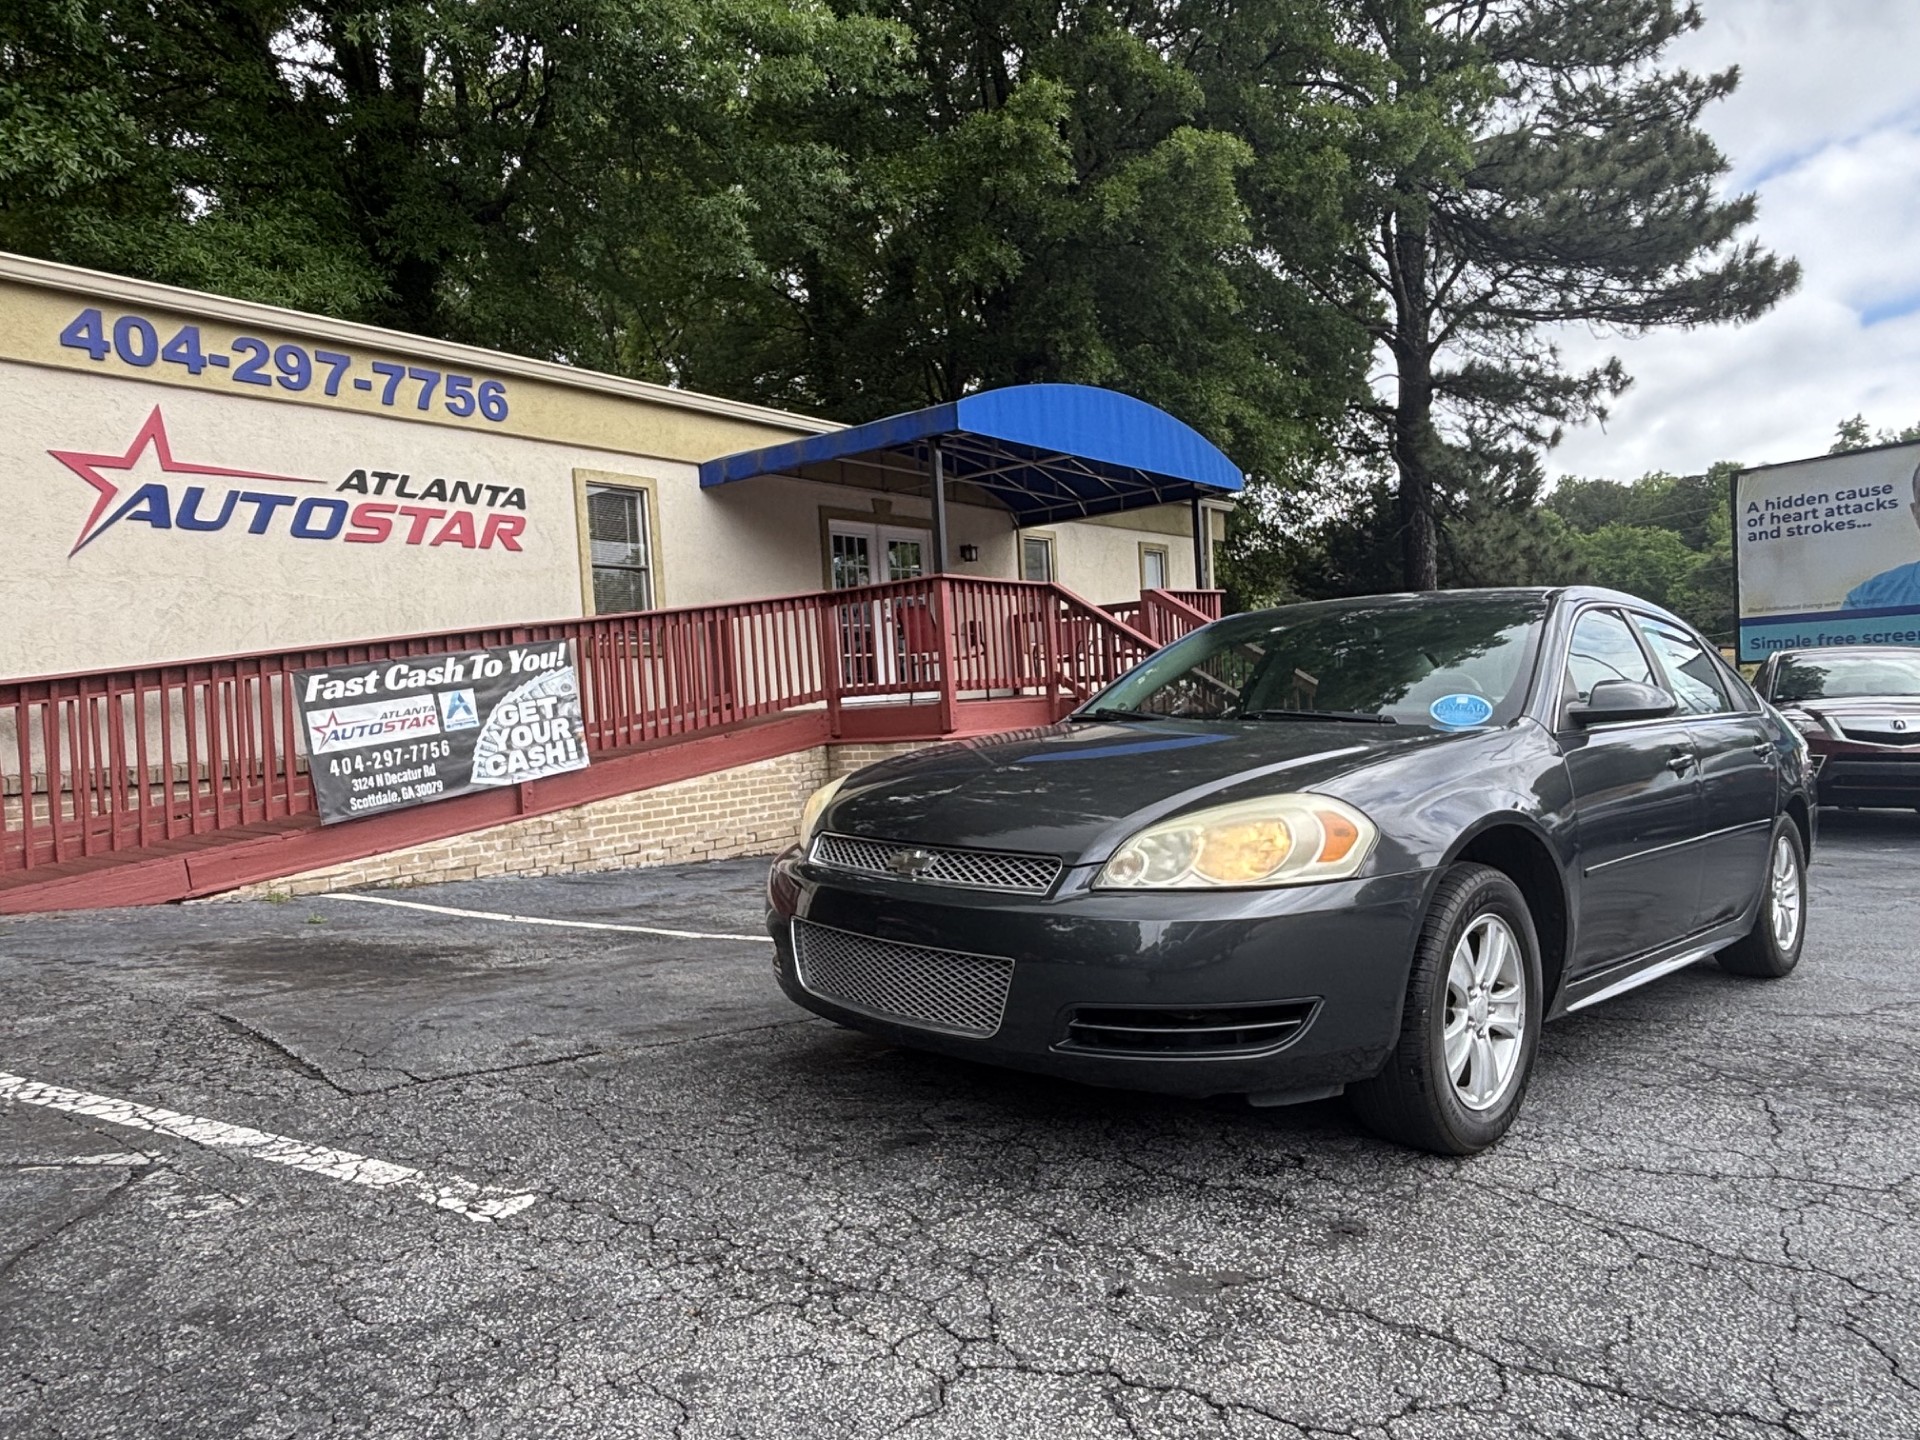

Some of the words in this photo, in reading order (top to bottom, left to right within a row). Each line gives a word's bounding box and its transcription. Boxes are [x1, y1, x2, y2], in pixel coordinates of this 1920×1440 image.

[60, 309, 509, 421] 404-297-7756
[336, 469, 527, 510] ATLANTA
[1747, 502, 1760, 514] A
[1765, 494, 1829, 511] hidden
[1835, 484, 1893, 502] cause
[70, 484, 526, 555] AUTOSTAR
[1747, 514, 1765, 528] of
[1770, 508, 1819, 525] heart
[1825, 498, 1899, 518] attacks
[1748, 526, 1781, 542] and
[1787, 519, 1872, 537] strokes...
[1750, 635, 1812, 650] Simple
[1817, 633, 1856, 647] free
[304, 669, 380, 702] Fast
[385, 657, 464, 690] Cash
[469, 653, 503, 680] To
[508, 642, 566, 674] You!
[380, 704, 435, 720] ATLANTA
[497, 697, 557, 726] GET
[324, 714, 436, 742] AUTOSTAR
[489, 718, 572, 751] YOUR
[329, 740, 450, 777] 404-297-7756
[485, 738, 578, 776] CASH!
[352, 775, 374, 792] 3124
[376, 774, 384, 787] N
[385, 768, 422, 786] Decatur
[423, 763, 436, 778] Rd
[350, 791, 401, 811] Scottdale,
[402, 790, 415, 800] GA
[416, 780, 443, 798] 30079
